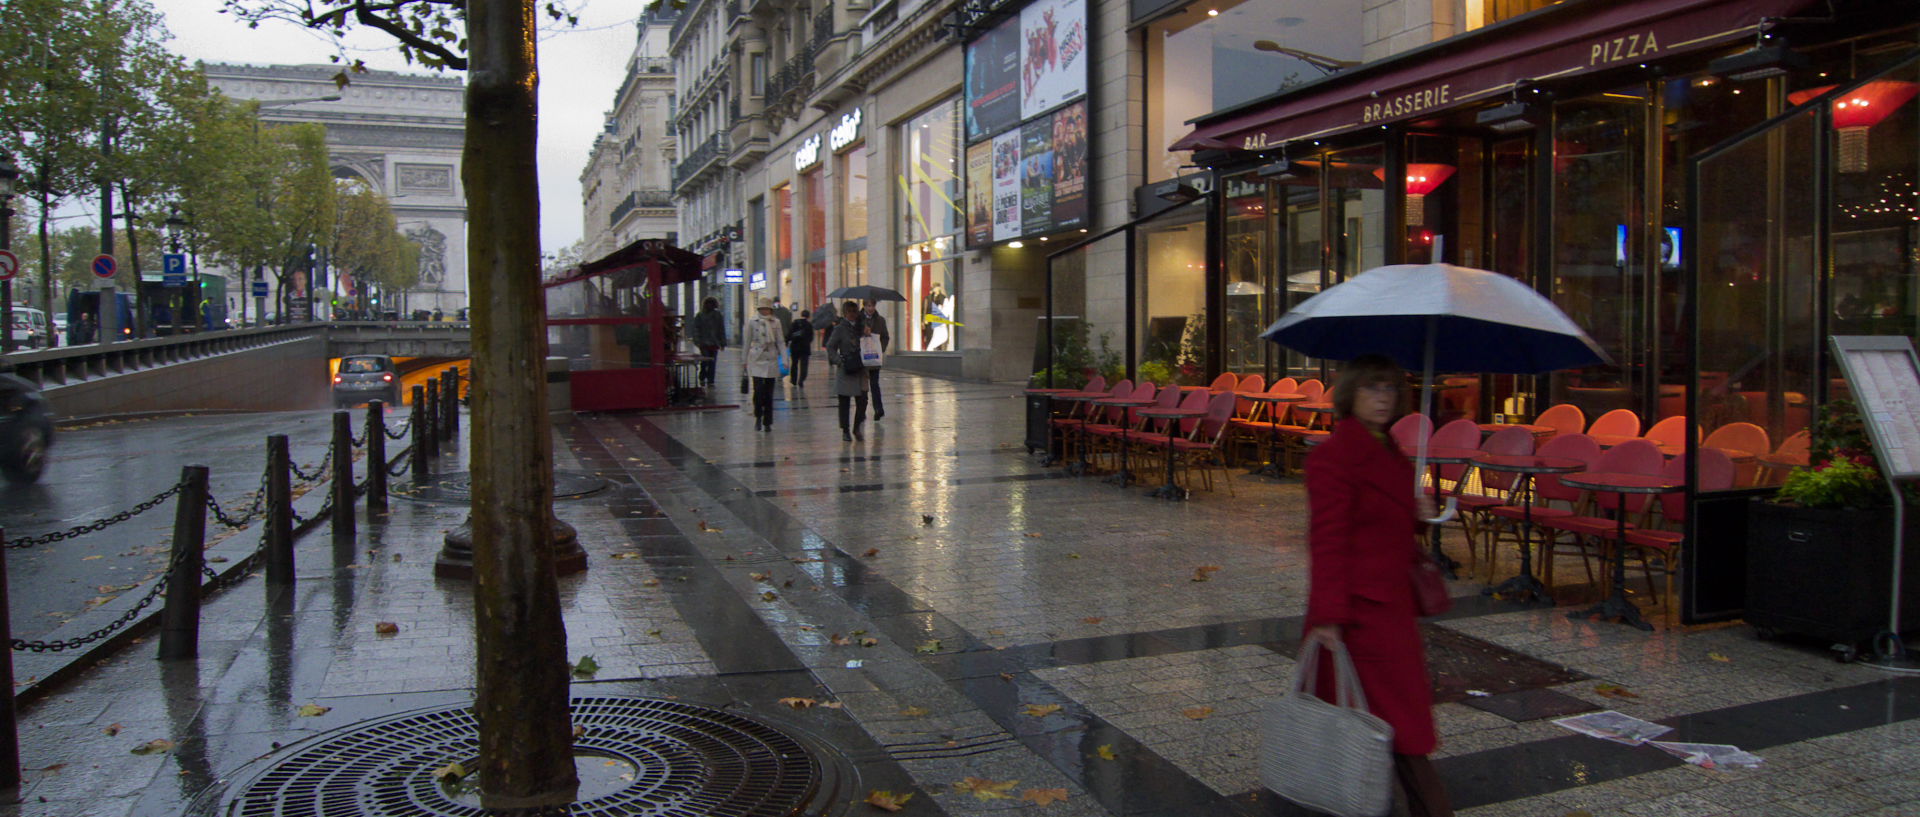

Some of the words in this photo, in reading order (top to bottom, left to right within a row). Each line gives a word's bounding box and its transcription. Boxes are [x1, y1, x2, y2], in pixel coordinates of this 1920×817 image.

[1591, 31, 1659, 66] PIZZA
[1363, 84, 1450, 123] BRASSERIE
[1244, 133, 1267, 151] BAR
[169, 258, 180, 272] P
